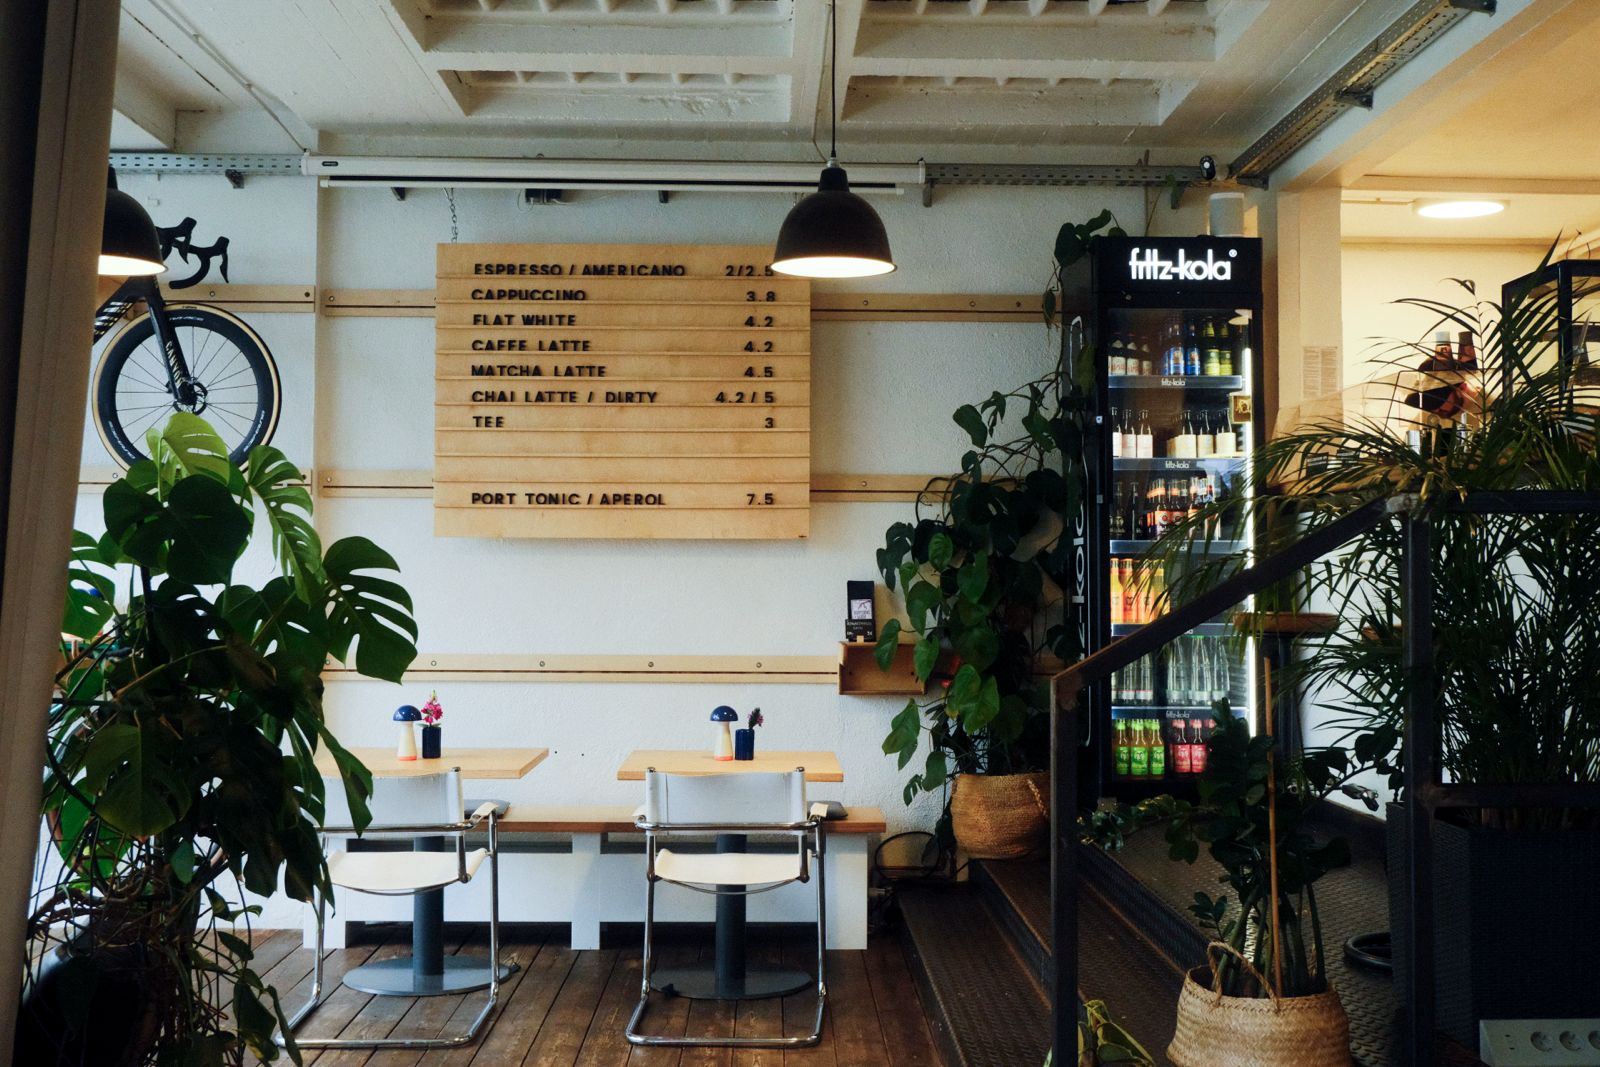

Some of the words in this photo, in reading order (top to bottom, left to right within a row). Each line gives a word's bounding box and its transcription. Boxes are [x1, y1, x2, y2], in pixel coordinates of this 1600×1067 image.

[474, 264, 563, 275] ESPRESSO
[581, 264, 687, 276] AMERICANO
[471, 289, 588, 301] CAPPUCCINO
[746, 291, 776, 302] 3.8
[473, 314, 515, 325] FLAT
[522, 315, 575, 326] WHITE
[744, 316, 773, 327] 4.2
[472, 340, 527, 351] CAFFE
[538, 340, 590, 351] LATTE
[744, 341, 773, 352] 4.2
[165, 340, 183, 389] CANYON
[472, 365, 543, 376] MATCHA
[554, 366, 605, 377] LATTE
[744, 367, 773, 377] 4.5
[472, 391, 515, 402] CHAI
[525, 391, 576, 402] LATTE
[606, 392, 657, 403] DIRTY
[473, 416, 504, 428] TEE
[765, 418, 773, 428] 3
[472, 493, 516, 504] PORT
[525, 493, 579, 504] TONIC
[599, 493, 666, 505] APEROL
[747, 493, 773, 505] 7.5
